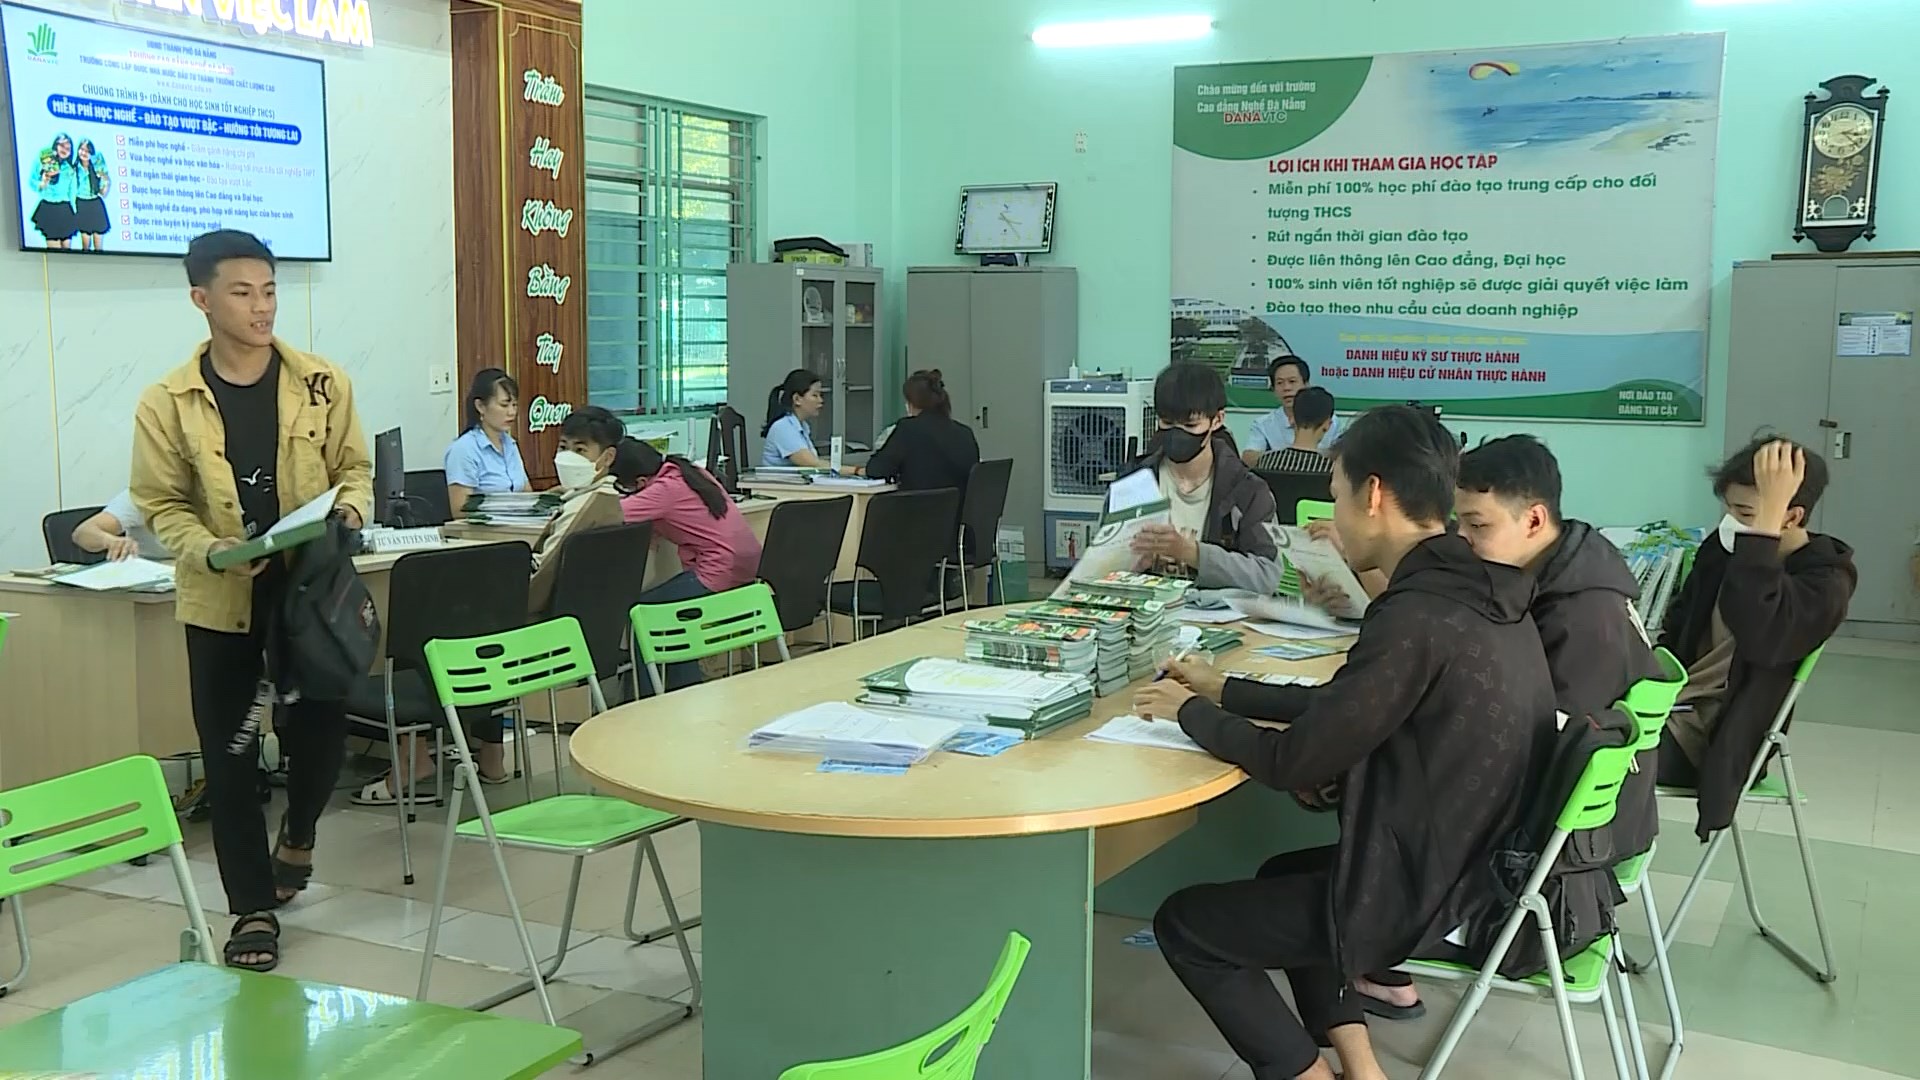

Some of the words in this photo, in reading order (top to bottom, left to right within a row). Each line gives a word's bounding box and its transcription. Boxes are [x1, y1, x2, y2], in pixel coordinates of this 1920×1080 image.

[1224, 111, 1288, 124] DANAVTC
[529, 136, 565, 180] Hay
[1269, 158, 1294, 175] LỢI
[1324, 158, 1348, 172] KHI
[1352, 157, 1395, 172] THAM
[1398, 156, 1426, 170] GIA
[1430, 156, 1463, 172] HỌC
[1467, 154, 1498, 170] TẬP
[1268, 180, 1303, 195] Miễn
[1307, 181, 1331, 196] phí
[1335, 182, 1374, 194] 100%
[1378, 181, 1406, 196] học
[1412, 180, 1436, 195] phí
[1440, 180, 1472, 192] đào
[1476, 179, 1502, 194] tạo
[1508, 178, 1550, 193] trung
[1554, 174, 1587, 192] cấp
[1592, 176, 1624, 188] cho
[1630, 172, 1657, 188] đối
[521, 199, 573, 239] Không
[1268, 208, 1310, 222] tượng
[1314, 206, 1352, 218] THCS
[1268, 230, 1290, 242] Rút
[1294, 228, 1332, 245] ngắn
[1336, 230, 1364, 242] thời
[1369, 230, 1402, 244] gian
[1407, 229, 1438, 242] đào
[1443, 230, 1468, 244] tạo
[1267, 254, 1304, 269] Được
[1309, 254, 1336, 266] liên
[1340, 254, 1382, 269] thông
[1387, 254, 1410, 266] lên
[1415, 254, 1448, 266] Cao
[1452, 250, 1498, 268] đẳng,
[1504, 254, 1530, 269] Đại
[1536, 254, 1566, 269] học
[527, 264, 571, 305] Bằng
[1267, 278, 1304, 290] 100%
[1308, 278, 1338, 290] sinh
[1342, 278, 1373, 290] viên
[1378, 276, 1400, 290] tốt
[1402, 278, 1456, 293] nghiệp
[1460, 278, 1477, 290] sẽ
[1482, 278, 1522, 294] được
[1528, 277, 1558, 294] giải
[1563, 276, 1610, 294] quyết
[1615, 278, 1650, 294] việc
[1656, 277, 1688, 291] làm
[1266, 301, 1296, 314] Đào
[1300, 302, 1324, 316] tạo
[1329, 302, 1361, 314] theo
[1366, 302, 1393, 314] nhu
[1398, 300, 1427, 315] cầu
[1432, 301, 1462, 315] của
[1466, 304, 1517, 316] doanh
[1522, 304, 1578, 320] nghiệp
[1346, 350, 1378, 360] DANH
[1382, 348, 1408, 363] HIỆU
[1412, 348, 1427, 361] KỸ
[1431, 350, 1449, 362] SƯ
[1450, 351, 1482, 365] THỰC
[1486, 350, 1520, 363] HÀNH
[1321, 366, 1349, 379] hoặc
[1352, 367, 1384, 378] DANH
[1388, 366, 1415, 381] HIỆU
[1418, 365, 1436, 379] CỬ
[1438, 368, 1472, 380] NHÂN
[1476, 368, 1508, 384] THỰC
[1512, 368, 1546, 382] HÀNH
[529, 396, 572, 432] Quen
